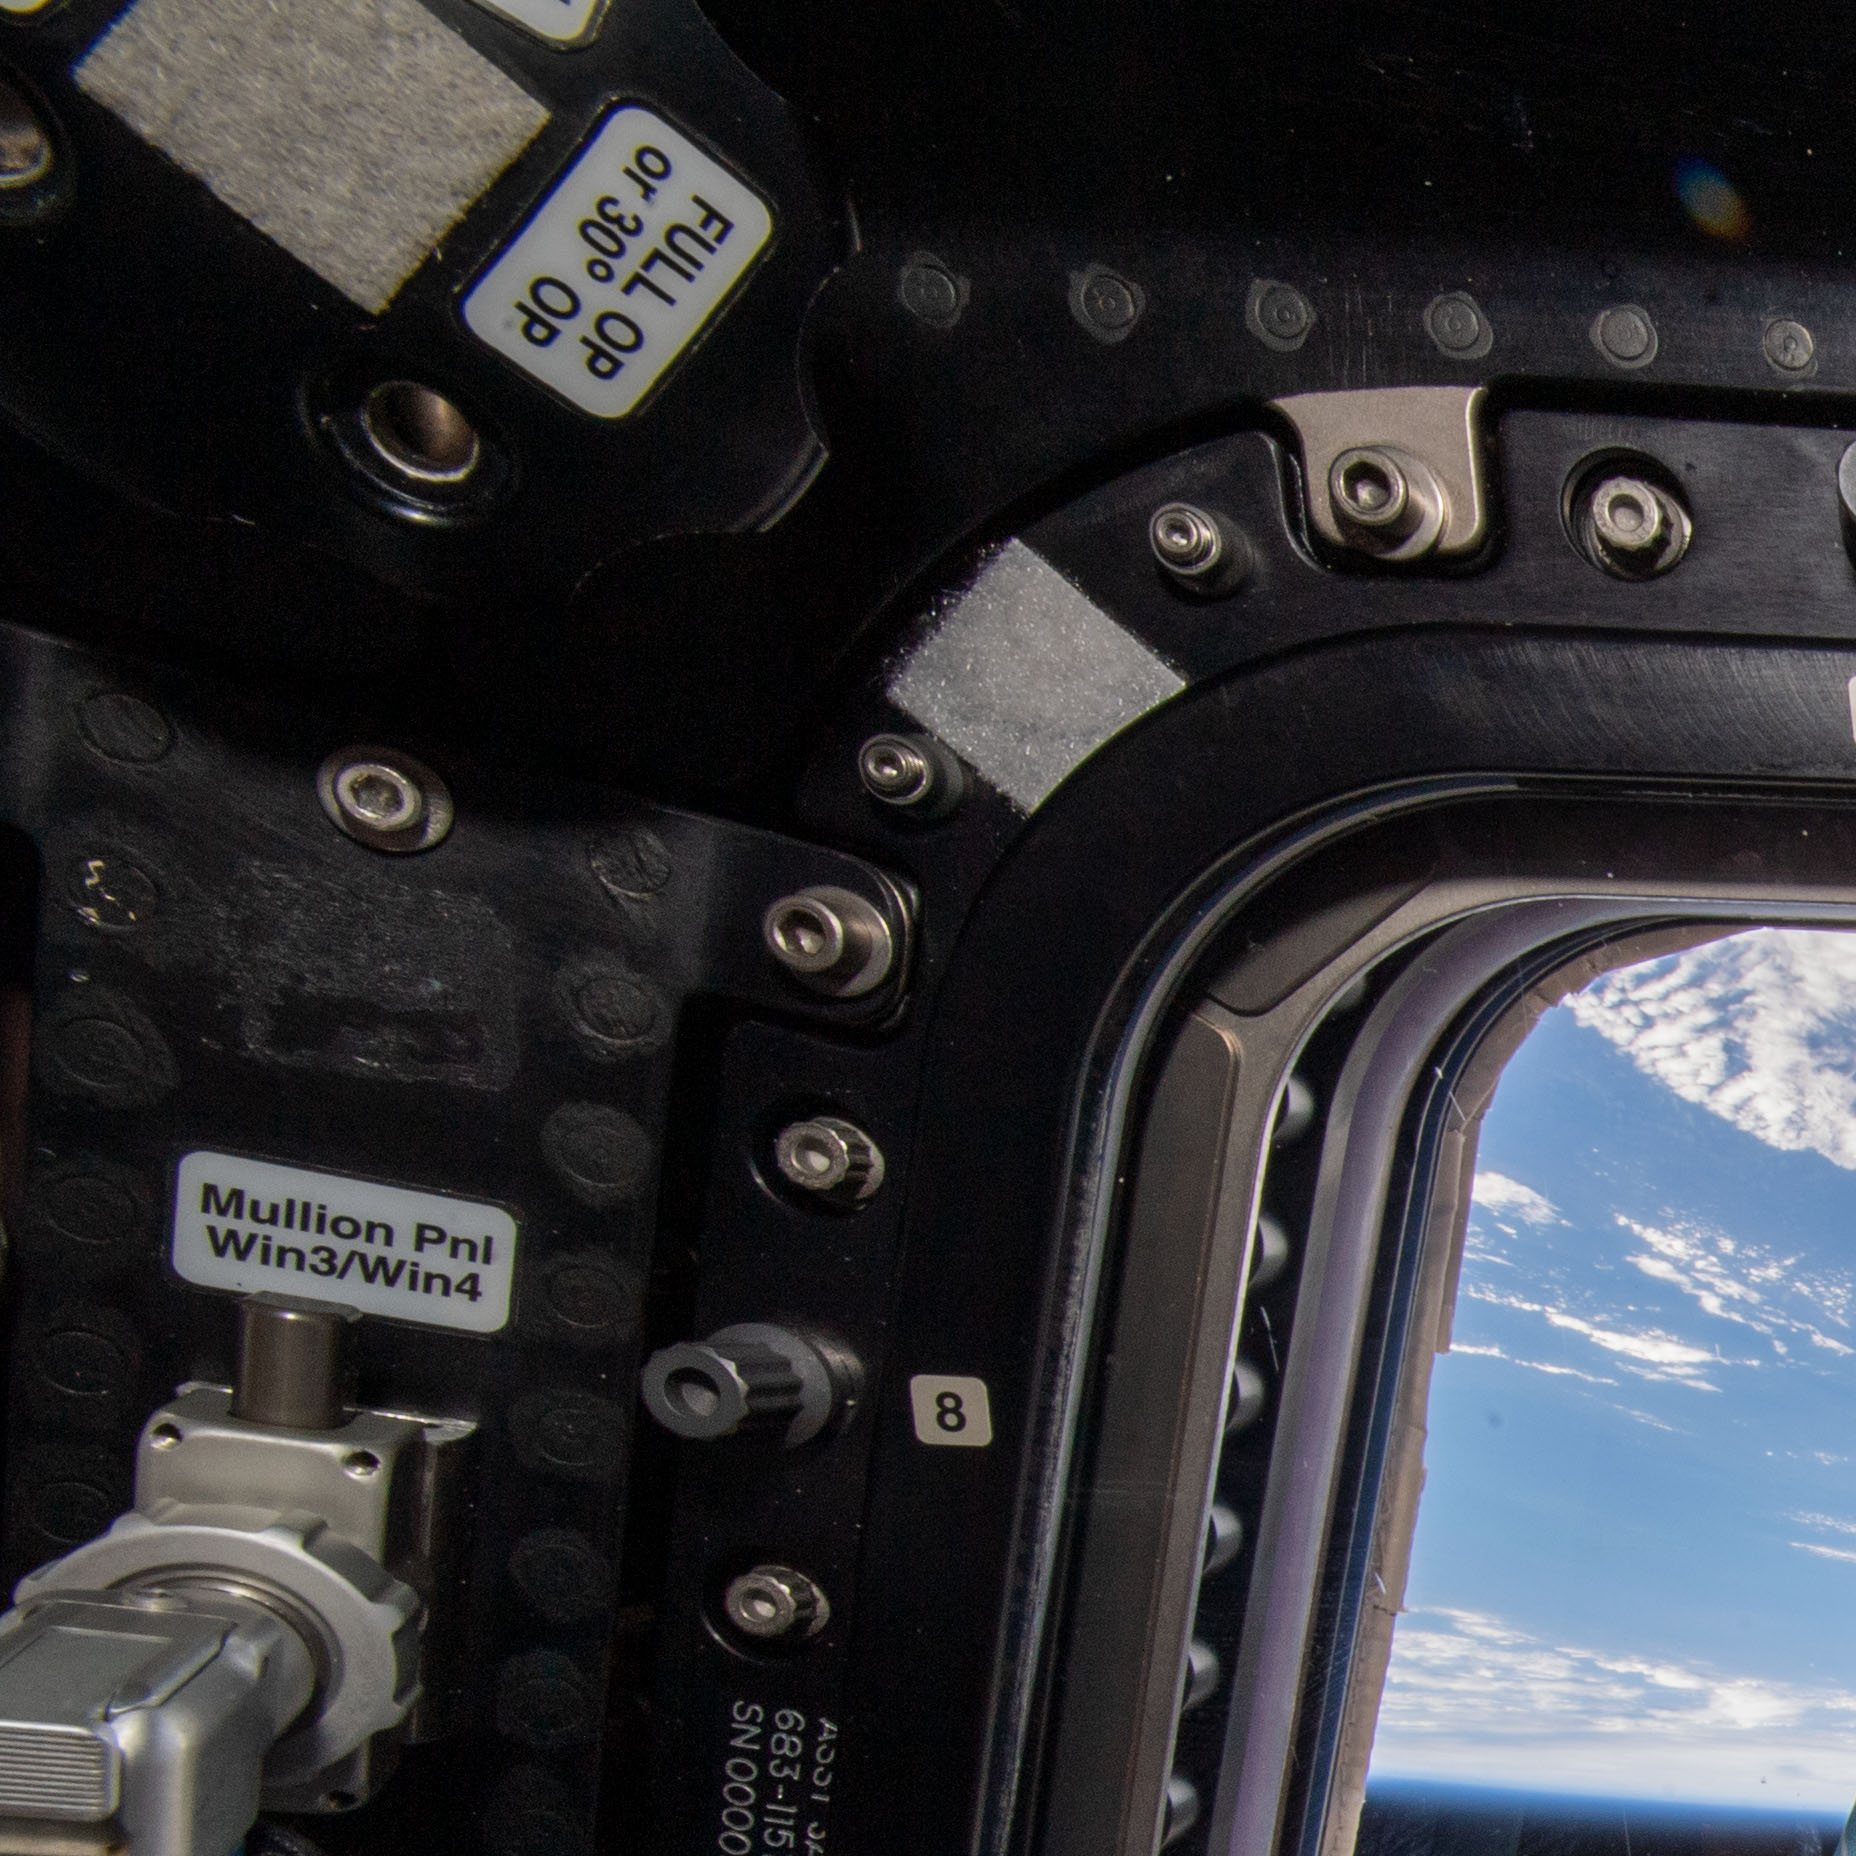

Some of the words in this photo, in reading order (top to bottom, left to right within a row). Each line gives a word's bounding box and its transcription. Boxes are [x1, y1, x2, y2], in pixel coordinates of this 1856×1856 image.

[623, 146, 672, 202] or
[622, 195, 734, 306] FULL
[515, 276, 581, 348] OP
[580, 311, 644, 381] OP
[201, 1182, 394, 1247] Mullion
[414, 1222, 493, 1265] Pnl
[206, 1224, 482, 1302] Win3/Win4
[935, 1391, 967, 1433] 8
